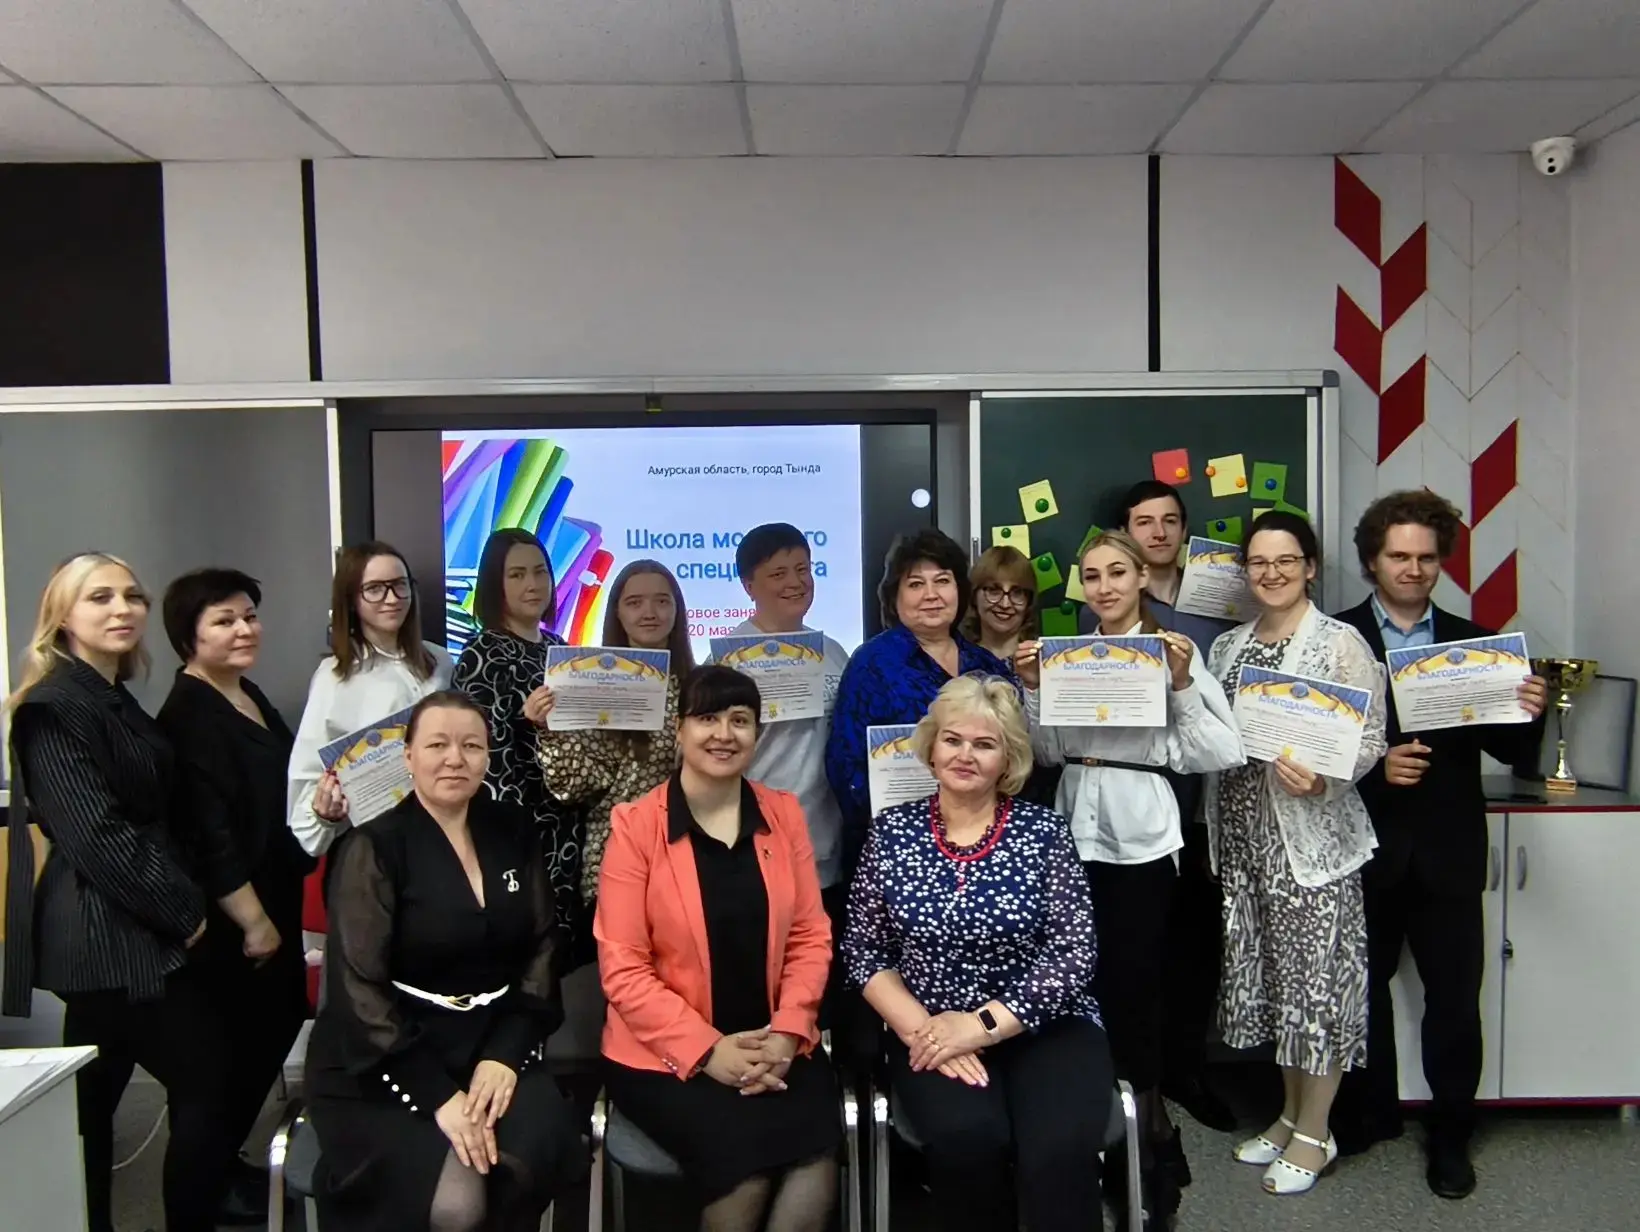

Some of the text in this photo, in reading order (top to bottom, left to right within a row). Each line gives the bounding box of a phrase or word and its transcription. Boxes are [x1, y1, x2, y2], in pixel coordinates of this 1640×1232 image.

[647, 463, 821, 477] Амурская область, город Тында
[626, 529, 705, 549] Школа
[688, 623, 705, 636] 20
